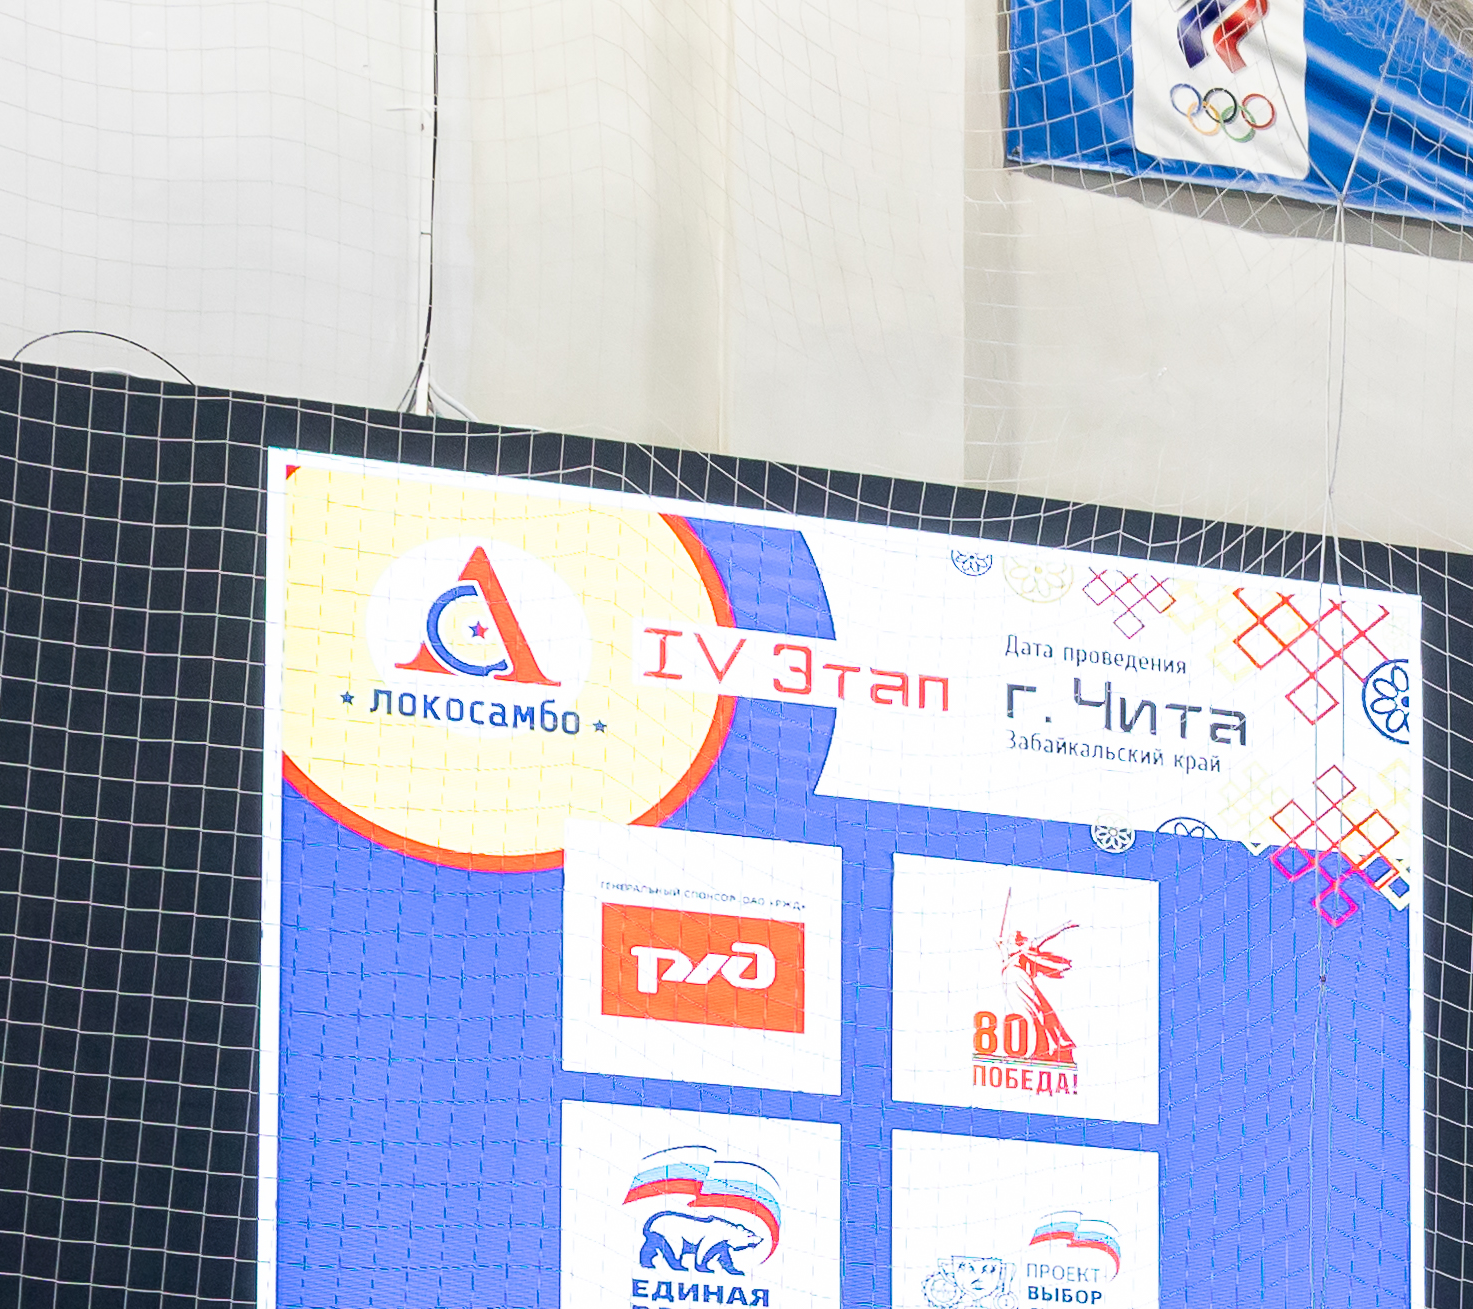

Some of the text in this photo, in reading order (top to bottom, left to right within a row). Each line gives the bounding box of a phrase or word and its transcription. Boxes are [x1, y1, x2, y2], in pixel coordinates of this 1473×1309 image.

[643, 627, 949, 712] IV Этап
[1005, 634, 1187, 675] Дата проведения
[1006, 677, 1248, 746] г. Чита
[1006, 730, 1222, 774] Забайкальский край
[973, 1010, 1031, 1057] 80
[972, 1065, 1079, 1096] ПОБЕДА!
[632, 1278, 770, 1308] ЕДИНАЯ
[1027, 1263, 1101, 1283] ПРОЕКТ
[1028, 1286, 1103, 1305] ВЫБОР
